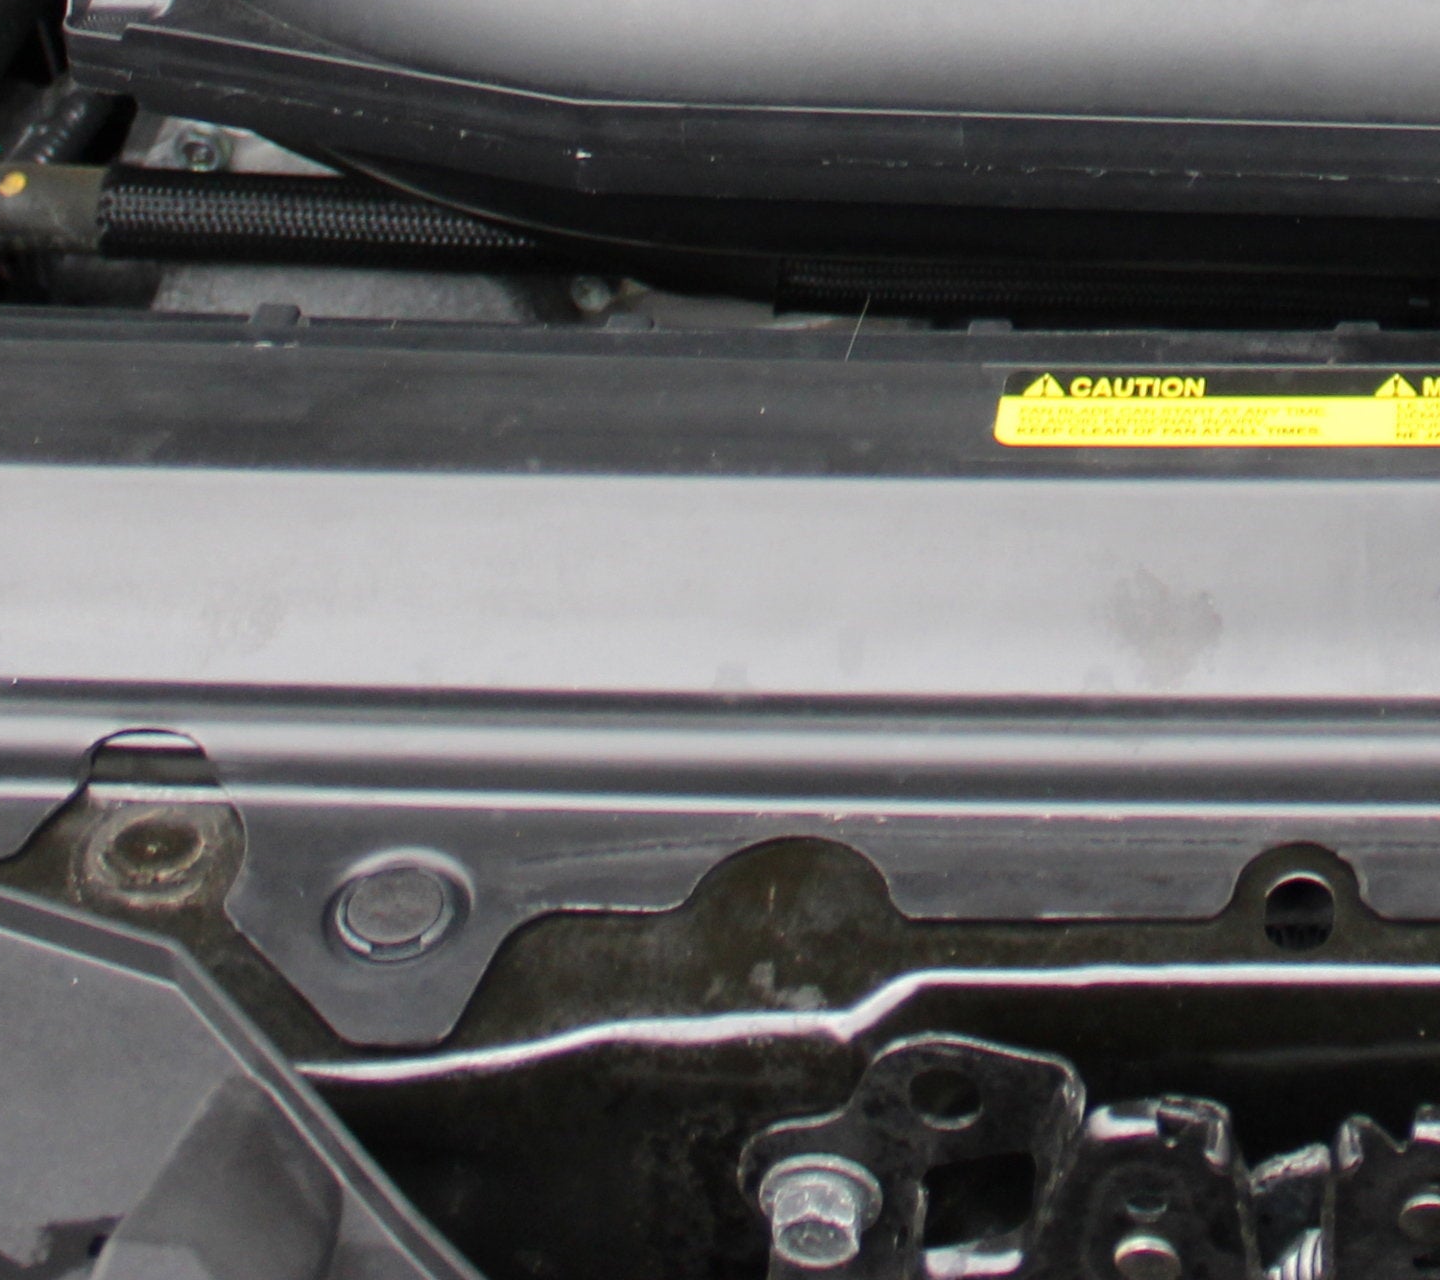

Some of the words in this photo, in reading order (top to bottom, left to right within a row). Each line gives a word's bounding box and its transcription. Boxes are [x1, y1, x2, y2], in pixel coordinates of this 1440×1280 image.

[1069, 376, 1207, 398] CAUTION
[1016, 426, 1061, 436] KEEP
[1067, 426, 1128, 436] CLEAR
[1161, 426, 1198, 436] FAN
